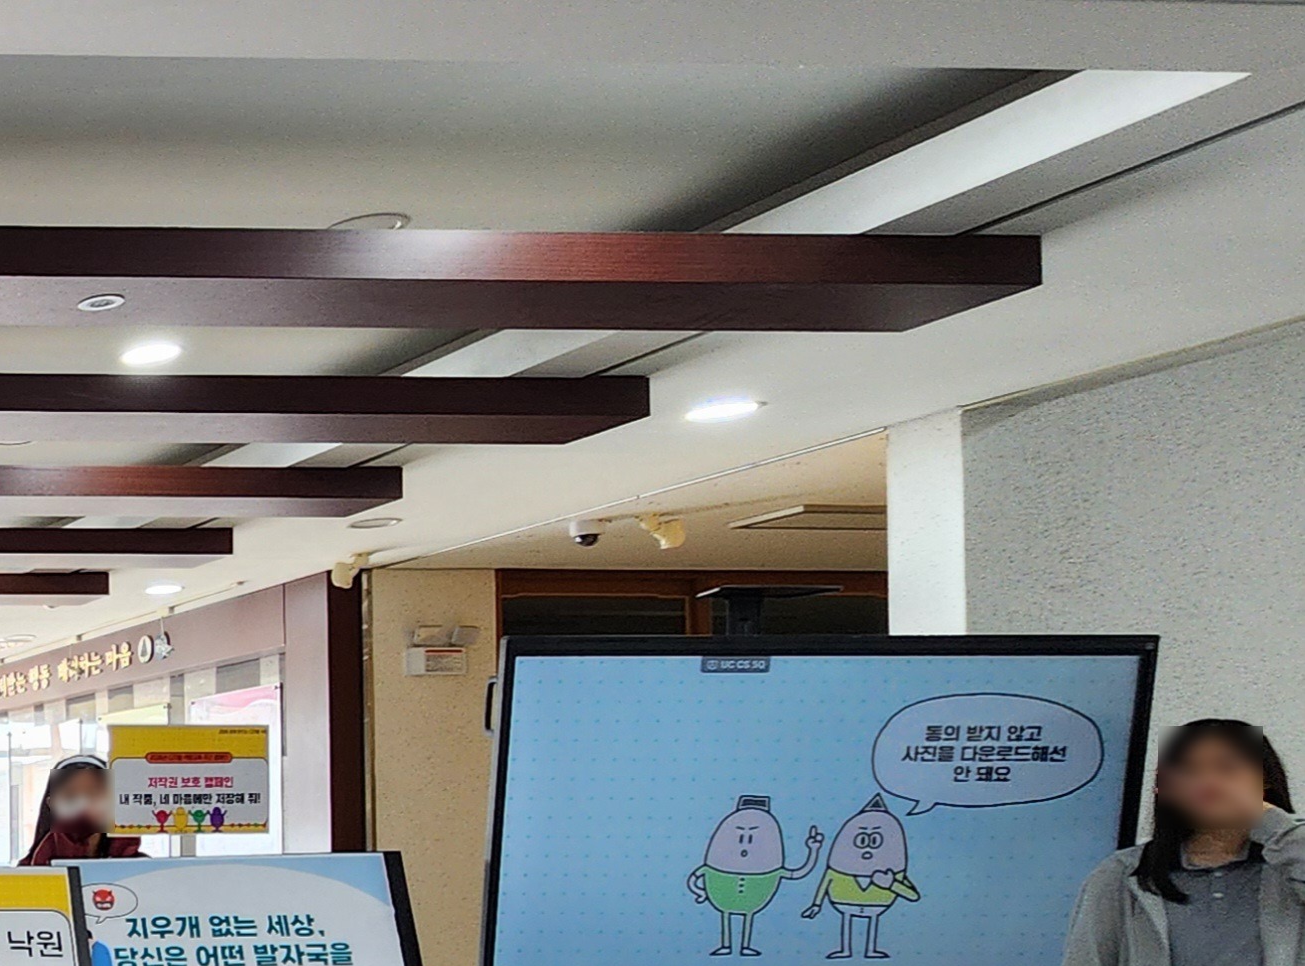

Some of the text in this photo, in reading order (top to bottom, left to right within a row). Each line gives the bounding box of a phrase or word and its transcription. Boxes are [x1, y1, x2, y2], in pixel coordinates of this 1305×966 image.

[925, 725, 1043, 742] 동의 받지 않고
[901, 745, 1068, 763] 사진을 다운로드해선
[181, 776, 201, 789] 보호
[953, 766, 1011, 783] 안 돼요
[119, 793, 129, 805] 내
[159, 793, 169, 805] 네
[125, 914, 326, 940] 지우개 없는 세상,
[7, 929, 64, 959] 낙원
[254, 942, 354, 966] 발자국을
